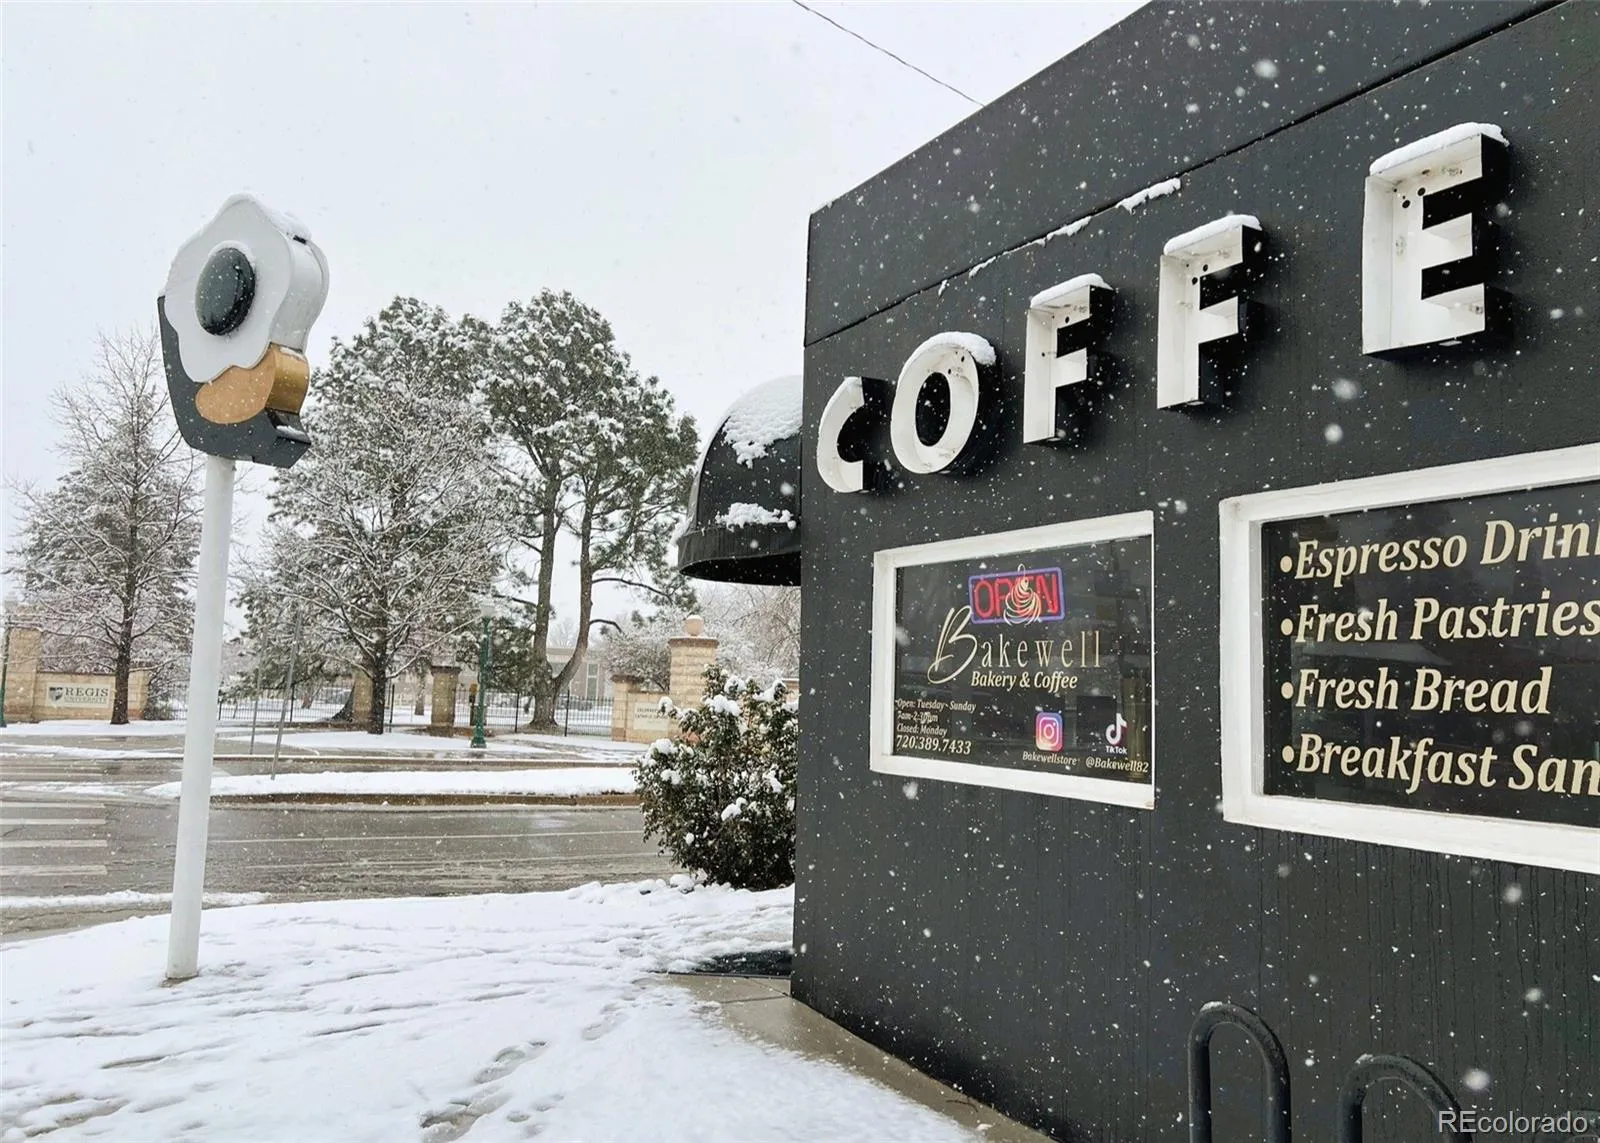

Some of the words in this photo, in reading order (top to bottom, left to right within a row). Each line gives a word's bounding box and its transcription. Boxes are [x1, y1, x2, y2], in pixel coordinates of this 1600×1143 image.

[1294, 534, 1467, 588] Espresso
[1480, 512, 1600, 566] Drin
[1295, 598, 1398, 643] Fresh
[1410, 588, 1600, 640] Pastries
[927, 605, 1100, 684] Bakewell
[65, 687, 109, 697] REGIS
[971, 671, 1016, 692] Bakery
[1019, 672, 1031, 688] &
[1034, 671, 1078, 694] Coffee
[1296, 666, 1399, 710] Fresh
[1411, 666, 1552, 714] Bread
[949, 700, 976, 714] Sunday
[920, 725, 947, 738] Monday
[896, 734, 972, 755] 720.389.7433
[1086, 756, 1149, 773] @Bakewell82
[1297, 733, 1498, 794] Breakfast
[1508, 743, 1600, 796] San
